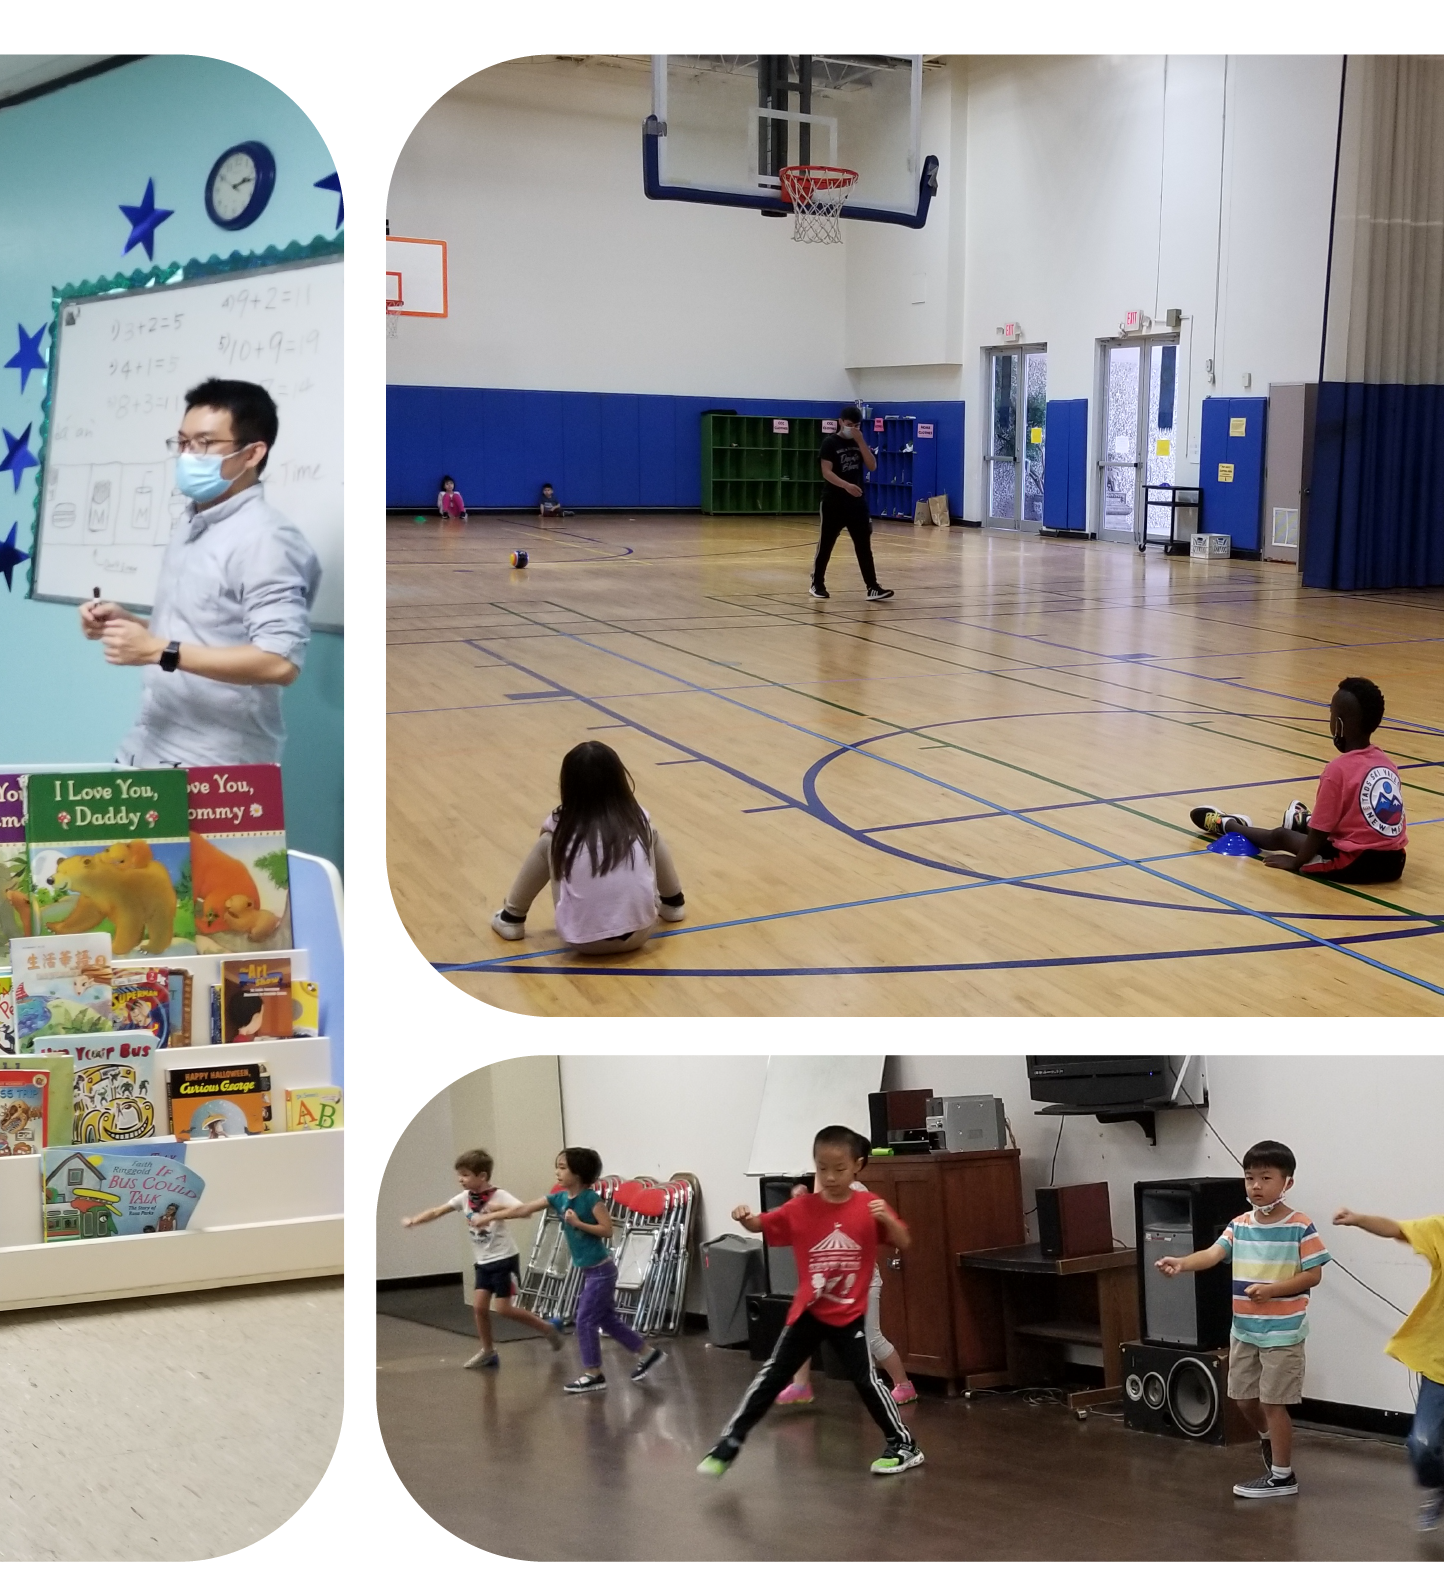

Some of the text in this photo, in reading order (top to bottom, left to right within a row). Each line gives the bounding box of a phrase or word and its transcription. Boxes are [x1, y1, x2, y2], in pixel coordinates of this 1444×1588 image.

[1126, 311, 1138, 325] EXIT
[1005, 323, 1015, 337] EXIT
[54, 778, 159, 801] I Love You,
[213, 773, 254, 796] You,
[75, 805, 141, 831] Daddy
[1366, 811, 1387, 832] NEW
[248, 963, 268, 979] Art
[119, 1043, 152, 1059] Bus
[184, 1071, 209, 1081] HAPPY
[16, 1089, 39, 1099] TRIP
[179, 1080, 256, 1095] Curious George
[112, 1166, 151, 1176] Ringgold
[131, 1160, 153, 1168] Faith
[108, 1175, 198, 1200] BUS COULD
[128, 1190, 162, 1205] TALK
